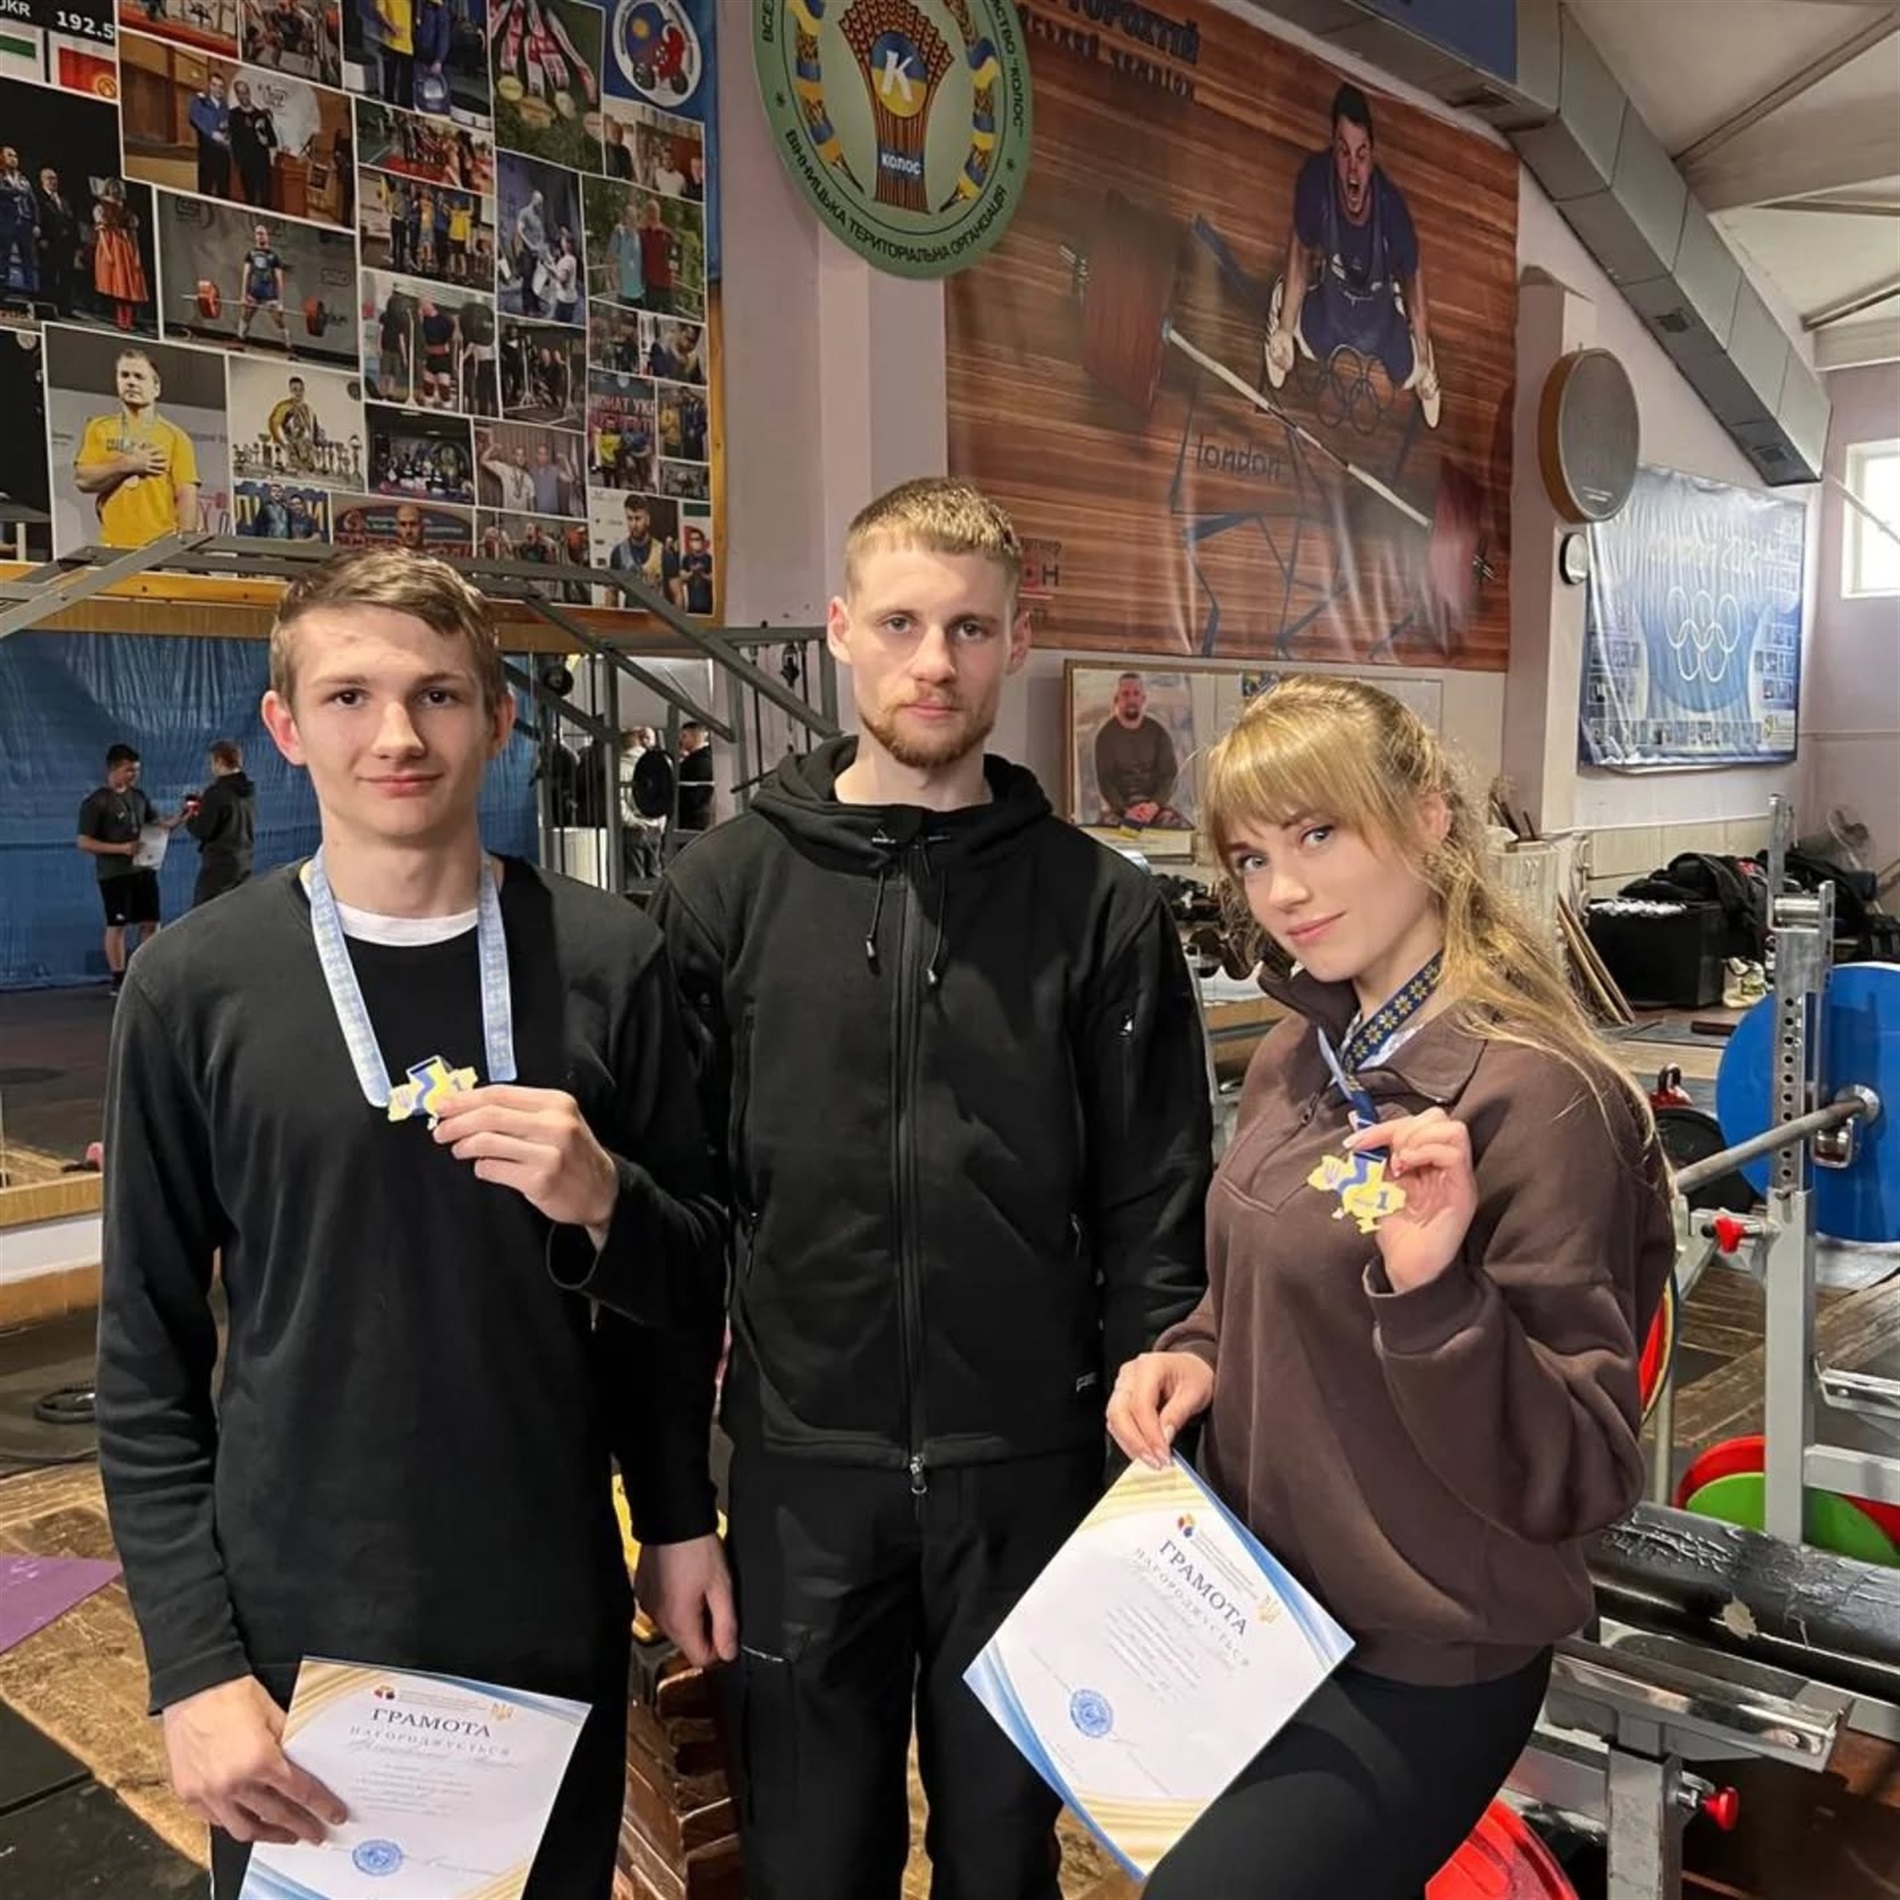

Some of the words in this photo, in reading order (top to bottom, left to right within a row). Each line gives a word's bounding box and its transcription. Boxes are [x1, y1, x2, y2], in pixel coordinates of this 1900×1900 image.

[56, 10, 114, 40] 192.5
[786, 129, 848, 228] ВІННИЦЬКА
[848, 218, 952, 263] ТЕРИТОРІАЛЬНА
[951, 184, 1009, 255] ОРГАНІЗАЦІЯ
[1159, 1539, 1248, 1635] ГРАМОТА
[371, 1707, 491, 1738] ГРАМОТА
